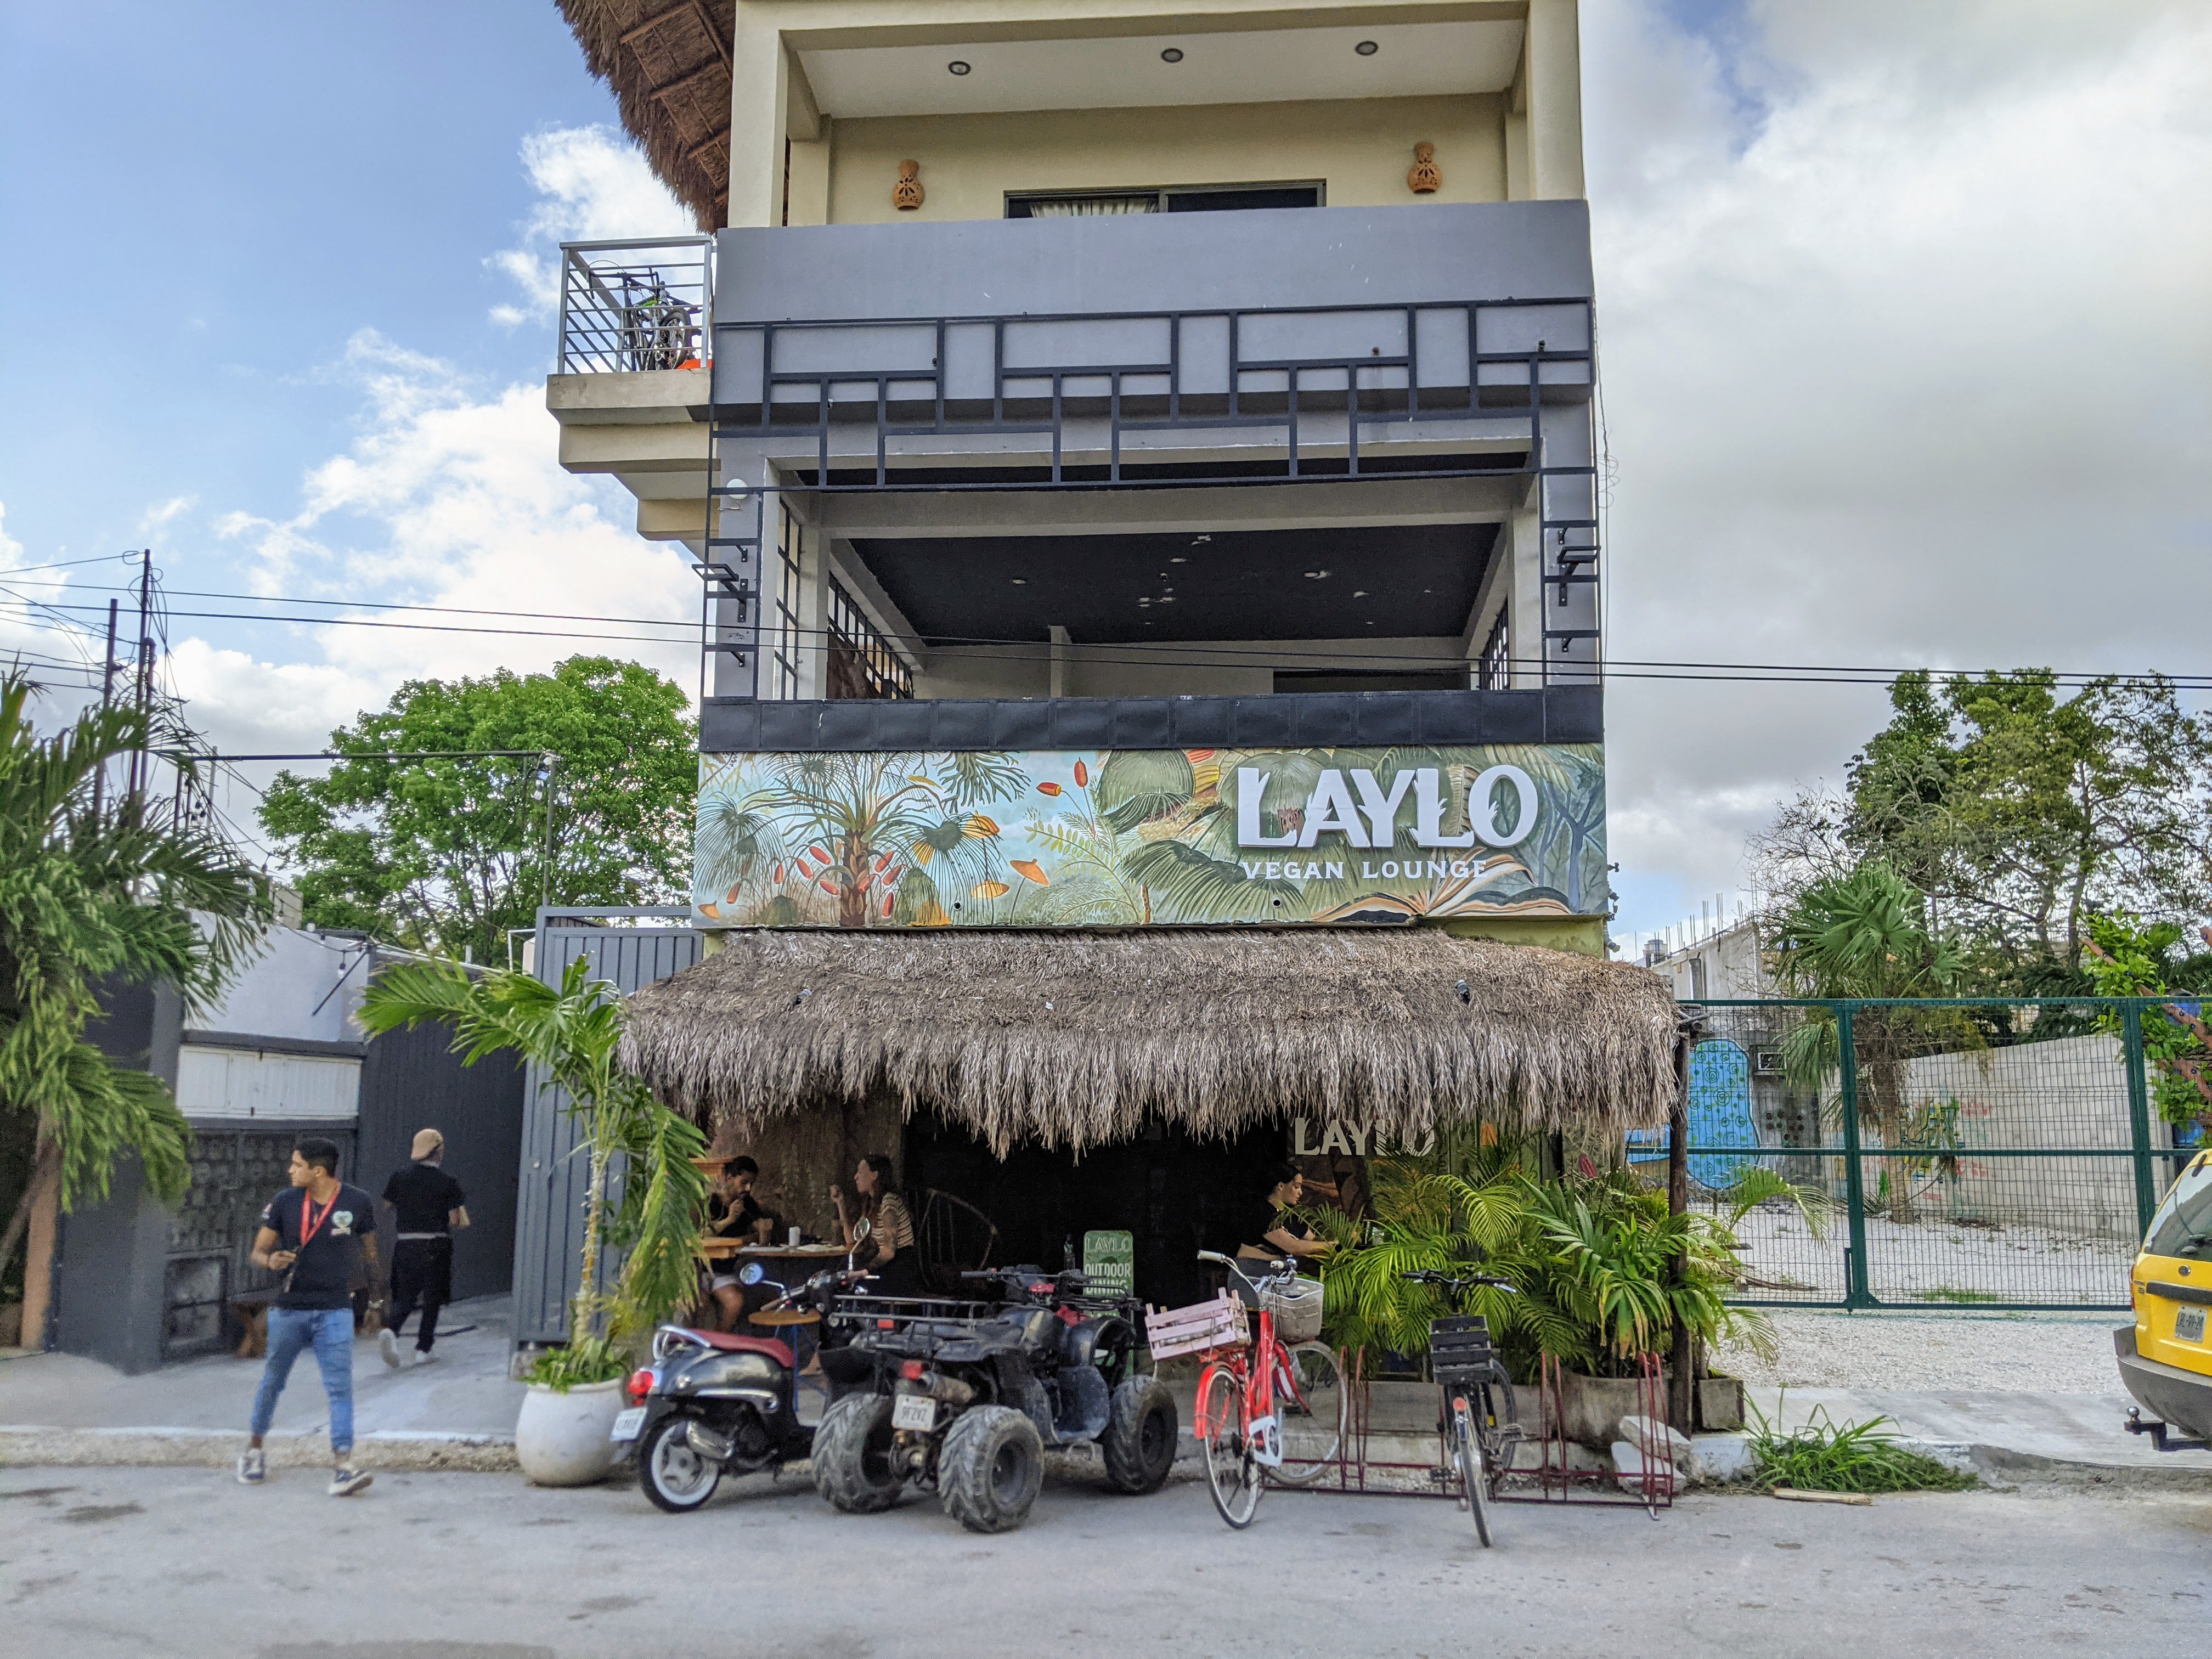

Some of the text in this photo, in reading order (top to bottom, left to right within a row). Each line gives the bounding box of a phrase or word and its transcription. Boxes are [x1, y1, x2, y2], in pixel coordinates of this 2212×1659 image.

[1238, 764, 1538, 848] LAYLO
[1242, 859, 1488, 879] VEGAN LOUNGE
[1085, 1237, 1132, 1252] LAYLO
[1084, 1262, 1131, 1277] OUTDOOR
